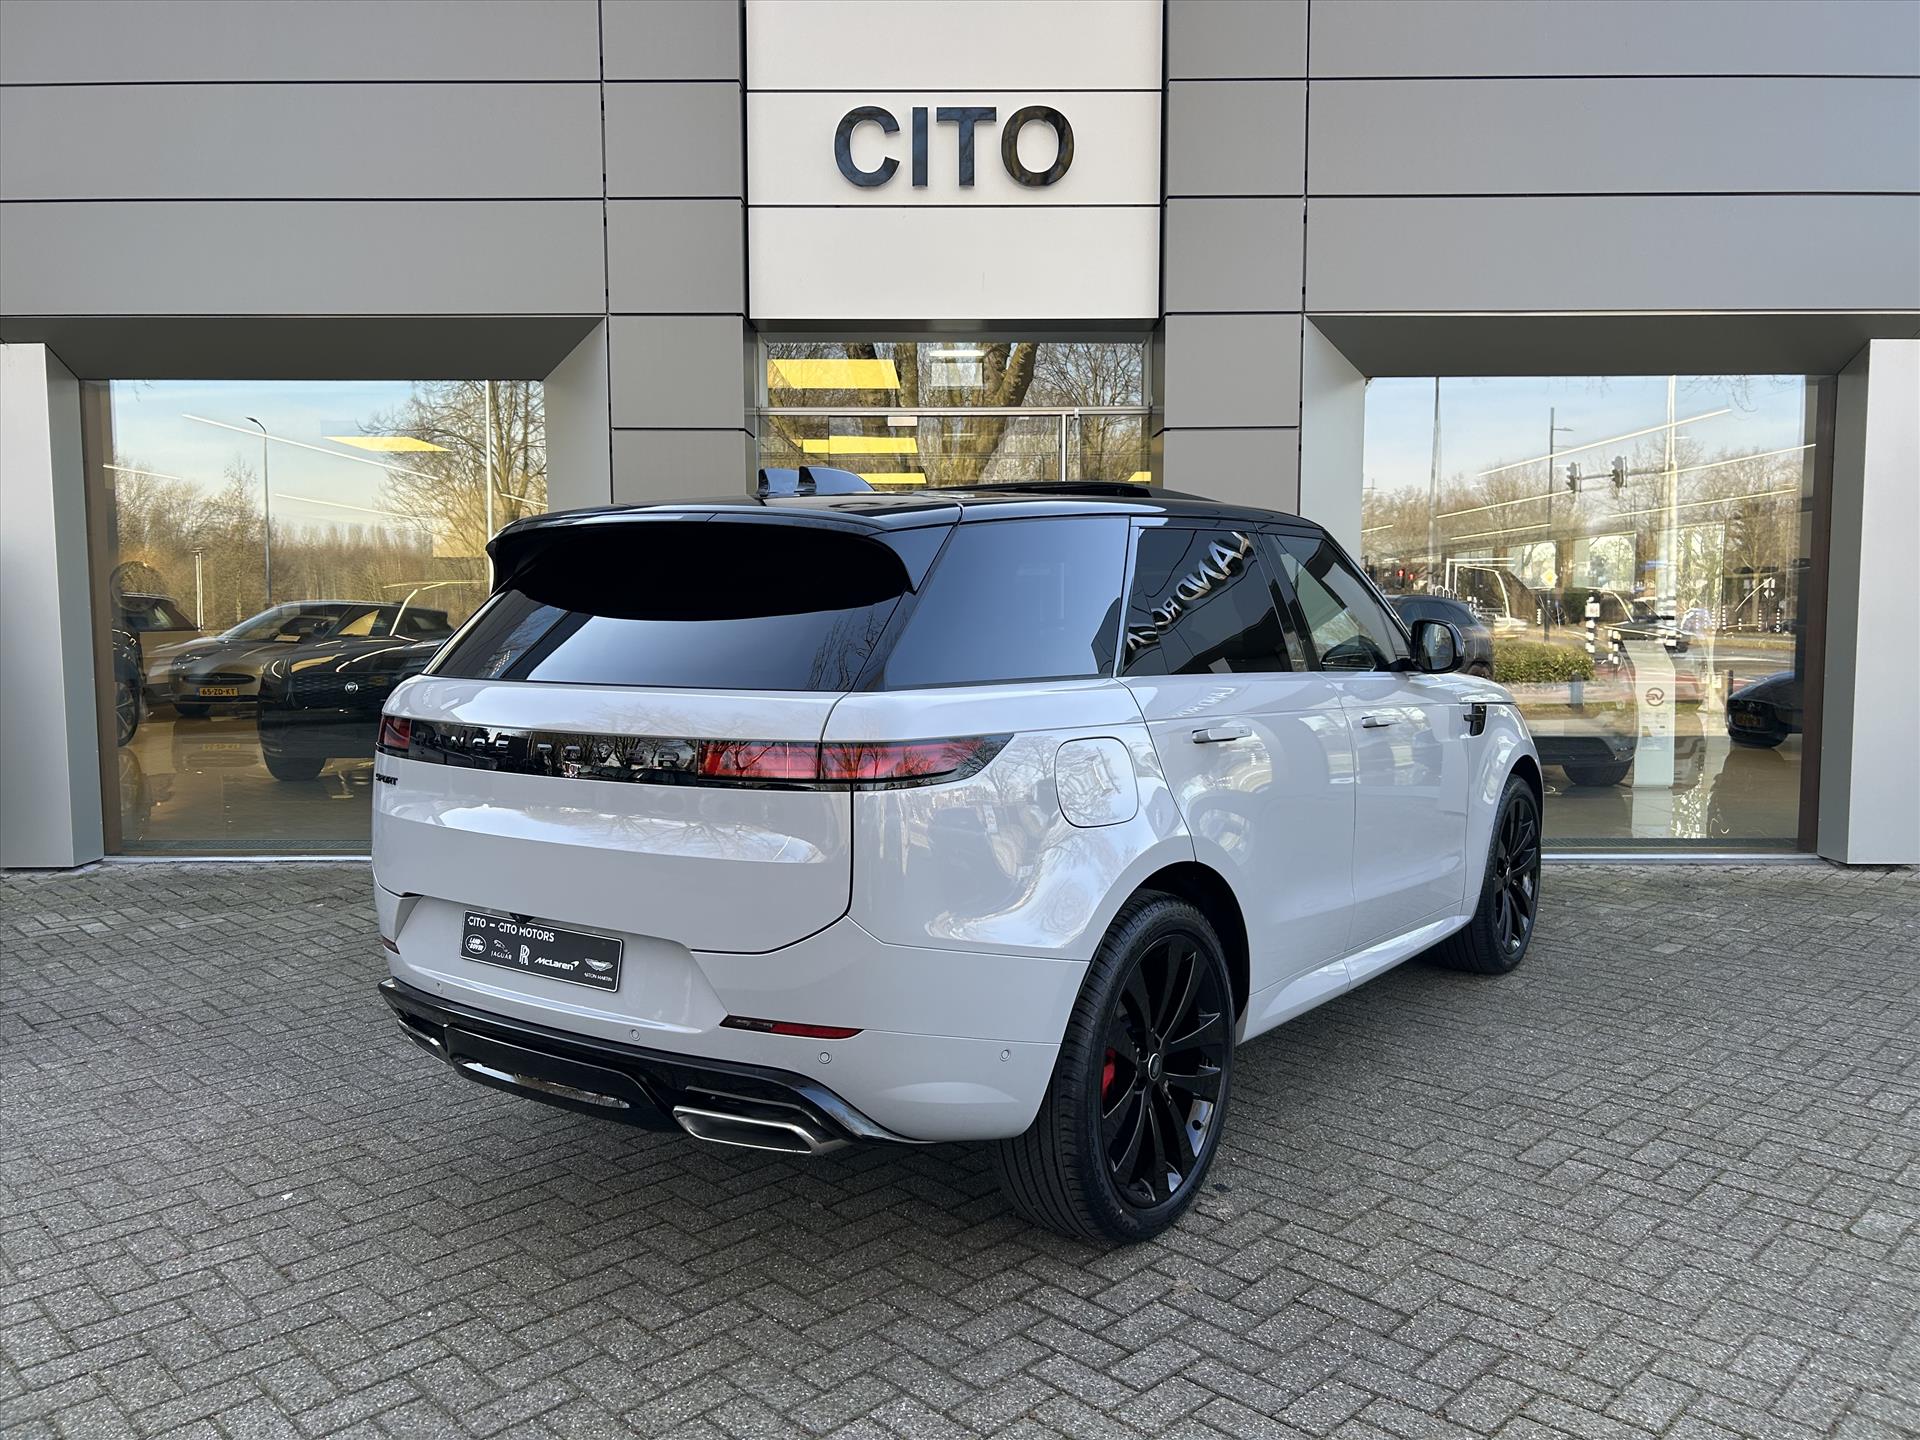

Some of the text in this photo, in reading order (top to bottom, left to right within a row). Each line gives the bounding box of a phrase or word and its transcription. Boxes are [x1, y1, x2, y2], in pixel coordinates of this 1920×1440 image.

[834, 105, 1074, 187] CITO
[468, 916, 486, 928] CITO
[498, 922, 517, 935] CITO
[519, 926, 555, 942] MOTORS
[491, 950, 512, 960] JAGUAR
[534, 957, 574, 971] McLaren
